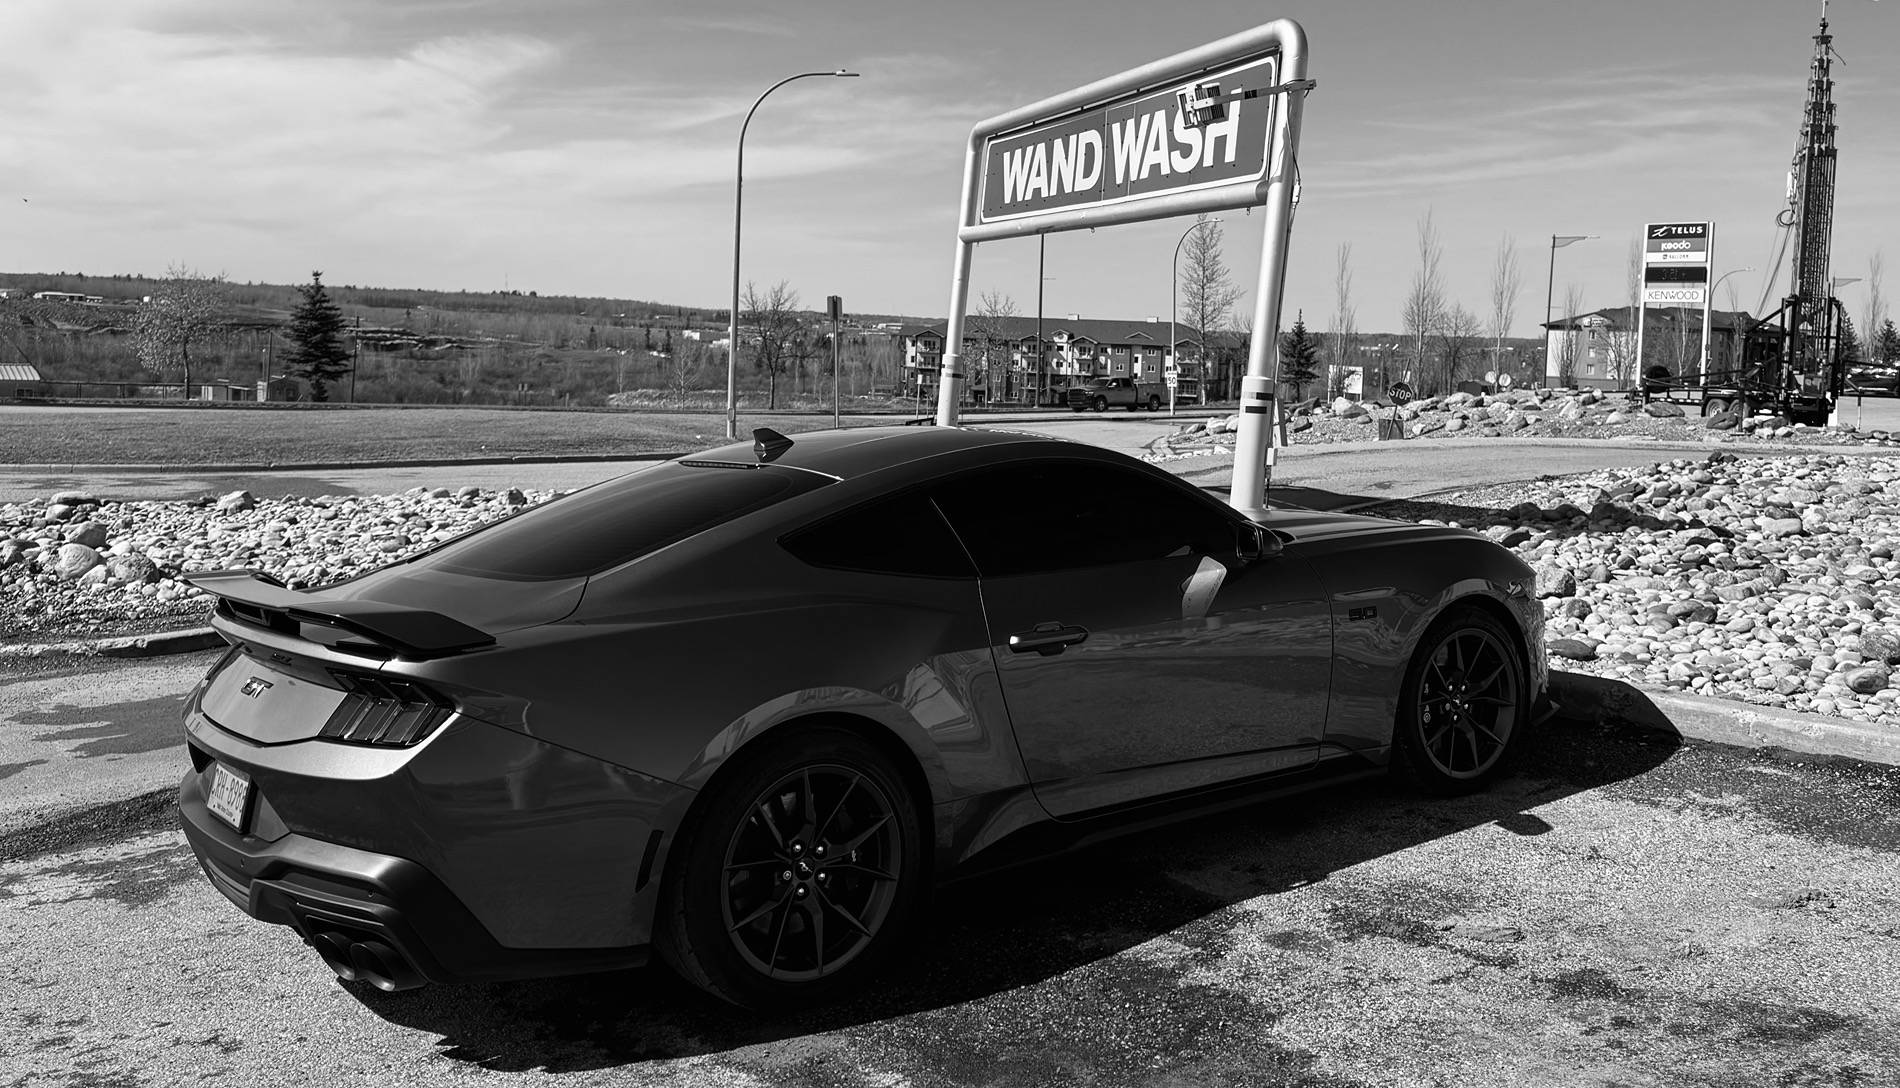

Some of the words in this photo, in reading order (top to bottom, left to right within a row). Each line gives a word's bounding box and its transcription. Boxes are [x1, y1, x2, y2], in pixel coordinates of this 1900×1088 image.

[1002, 129, 1103, 204] WAND
[1111, 87, 1242, 185] WASH
[1671, 226, 1703, 234] TELUS
[1661, 240, 1691, 251] koodo
[1648, 291, 1699, 300] KENWOOD
[1389, 387, 1412, 400] STOP
[241, 676, 274, 698] GT
